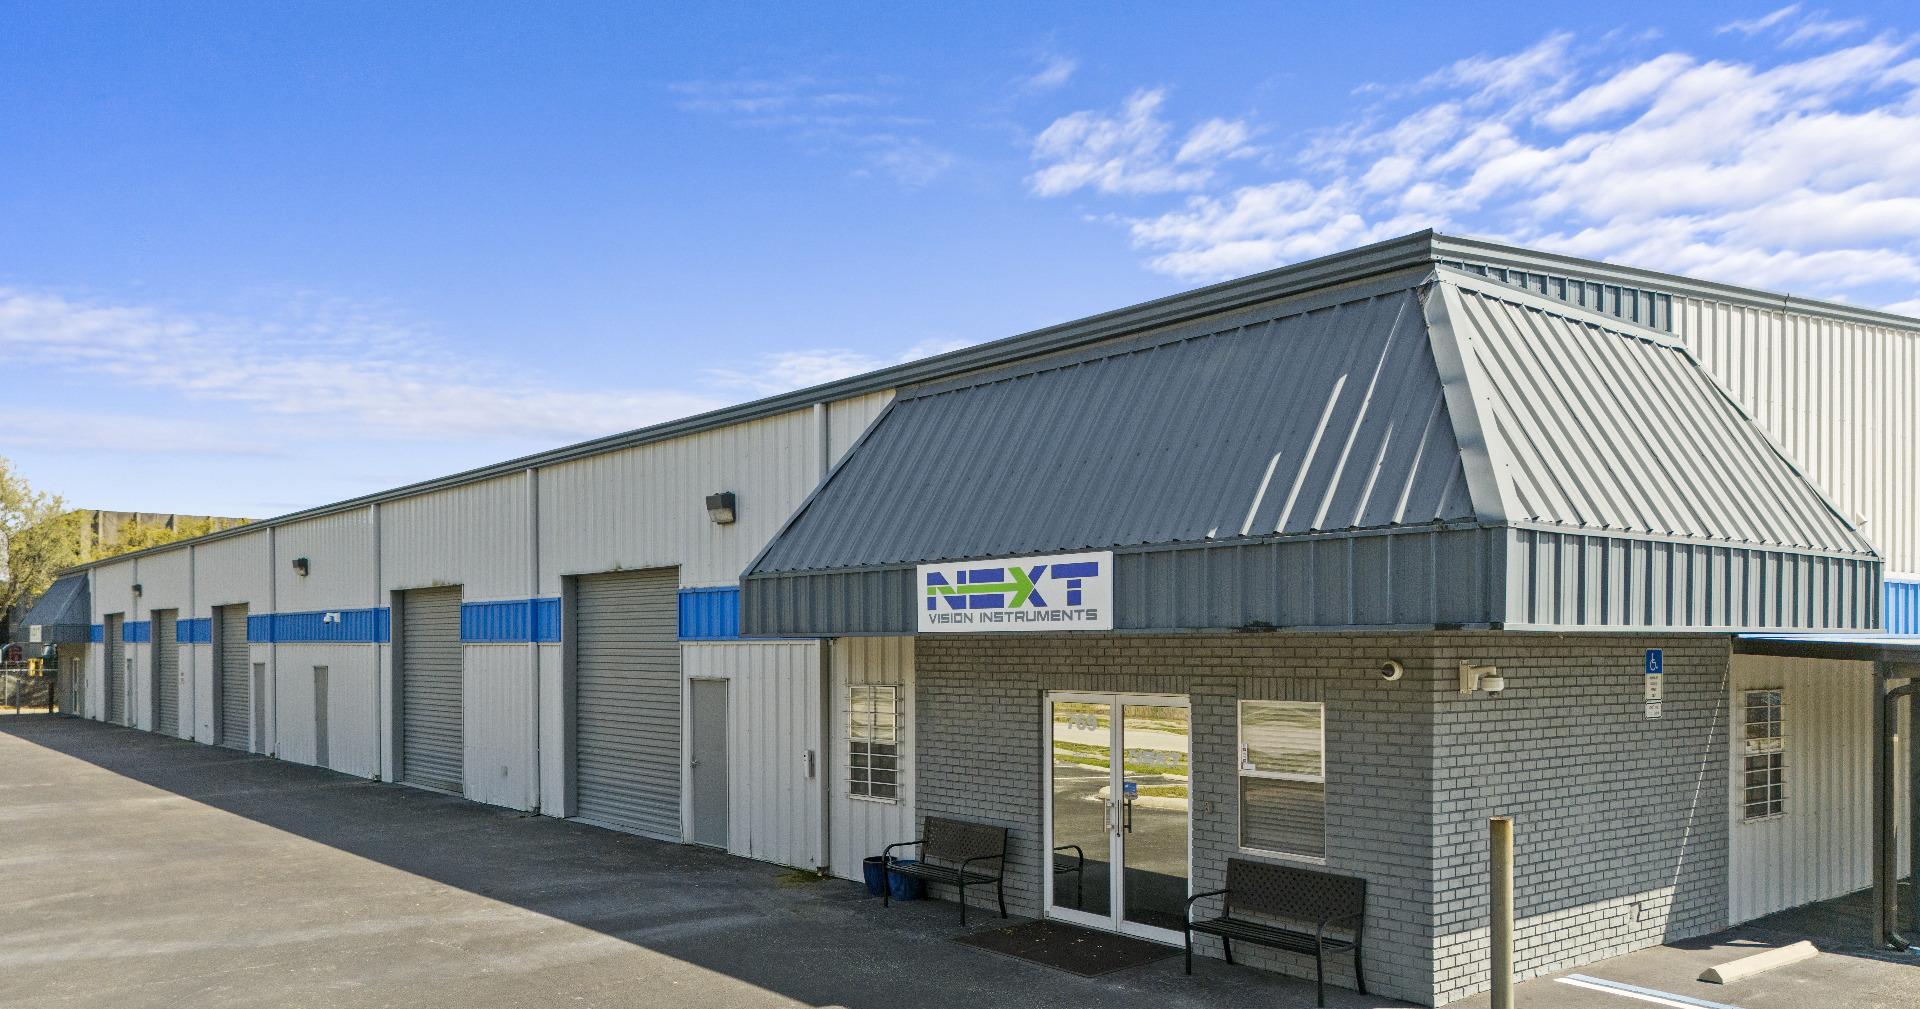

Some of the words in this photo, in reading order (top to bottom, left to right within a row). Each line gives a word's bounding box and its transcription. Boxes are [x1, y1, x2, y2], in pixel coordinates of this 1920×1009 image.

[927, 562, 1098, 610] NEXT
[929, 613, 973, 624] VISION
[980, 609, 1098, 623] INSTRUMENTS
[1066, 713, 1097, 731] 769
